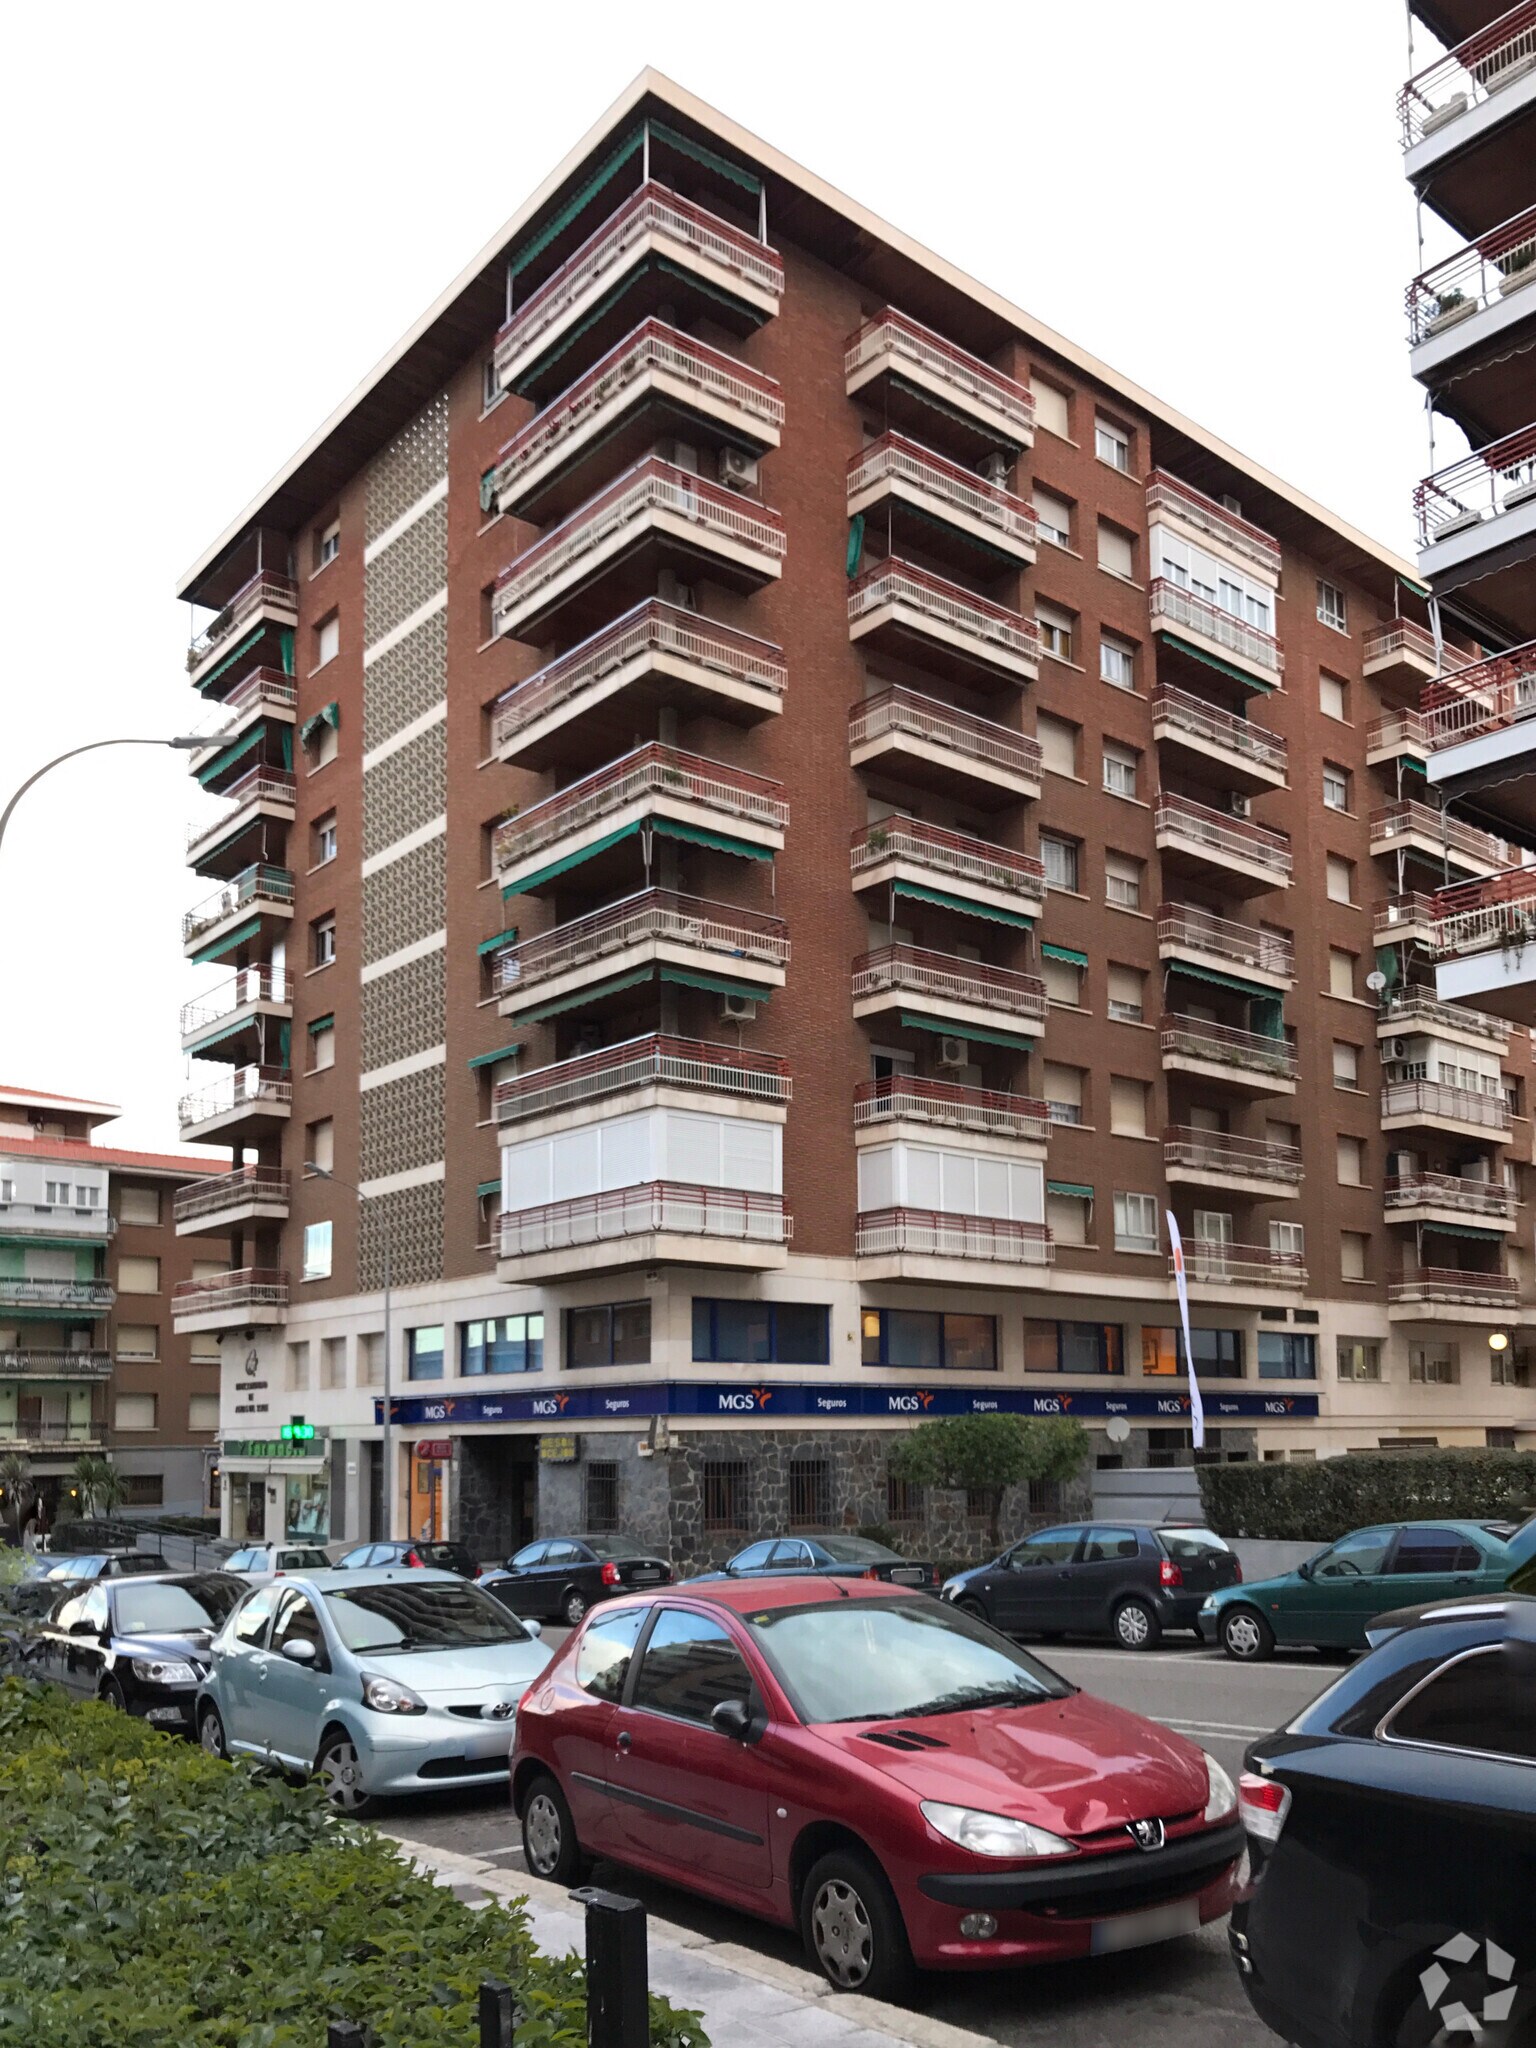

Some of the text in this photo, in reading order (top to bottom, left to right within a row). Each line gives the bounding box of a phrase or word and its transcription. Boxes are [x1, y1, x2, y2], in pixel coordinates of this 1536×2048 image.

[425, 1398, 630, 1419] MGS Seguros MGS Seguros
[719, 1394, 1286, 1414] MGS Seguros MGS Seguros MGS Seguros MGS Seguros MGS
